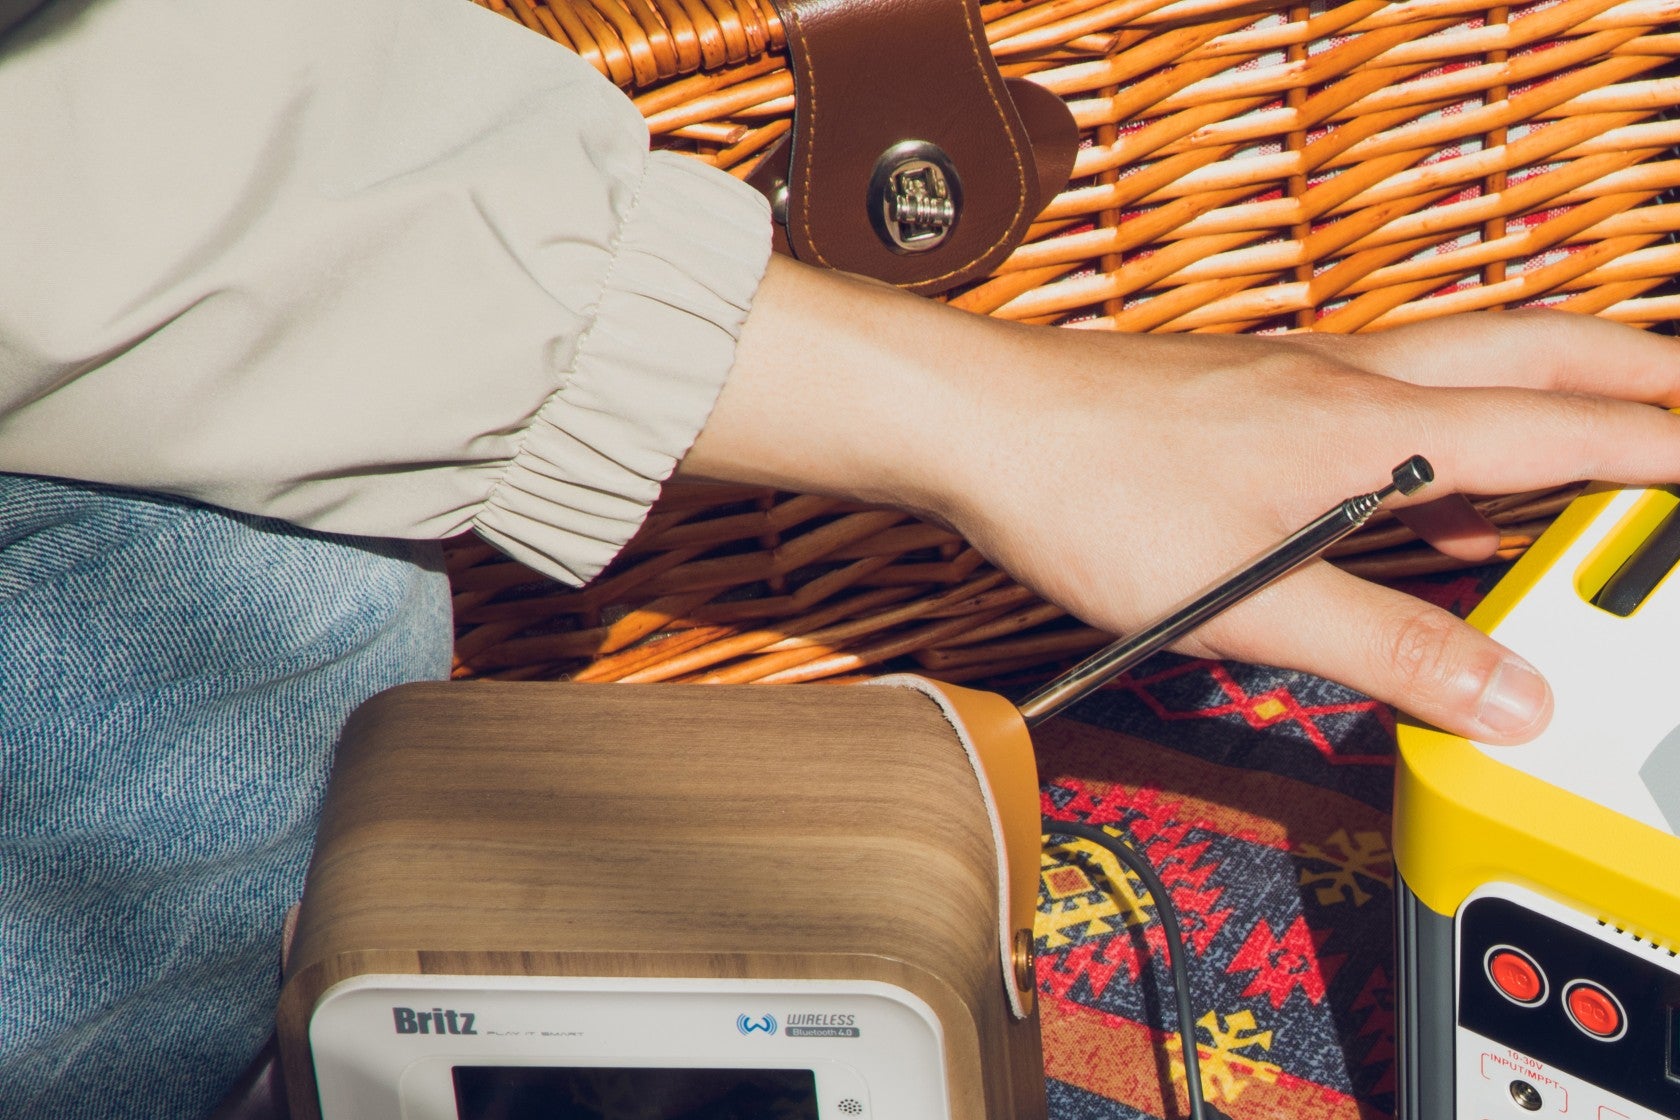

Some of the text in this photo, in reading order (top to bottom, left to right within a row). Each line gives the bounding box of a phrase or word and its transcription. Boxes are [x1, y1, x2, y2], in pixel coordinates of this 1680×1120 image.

[392, 1007, 478, 1035] Britz
[787, 1014, 855, 1026] WIRELESS
[793, 1028, 853, 1037] Bluetooth 4.0
[1507, 1050, 1544, 1070] 10-30V
[1490, 1053, 1560, 1089] INPUT/MPPT
